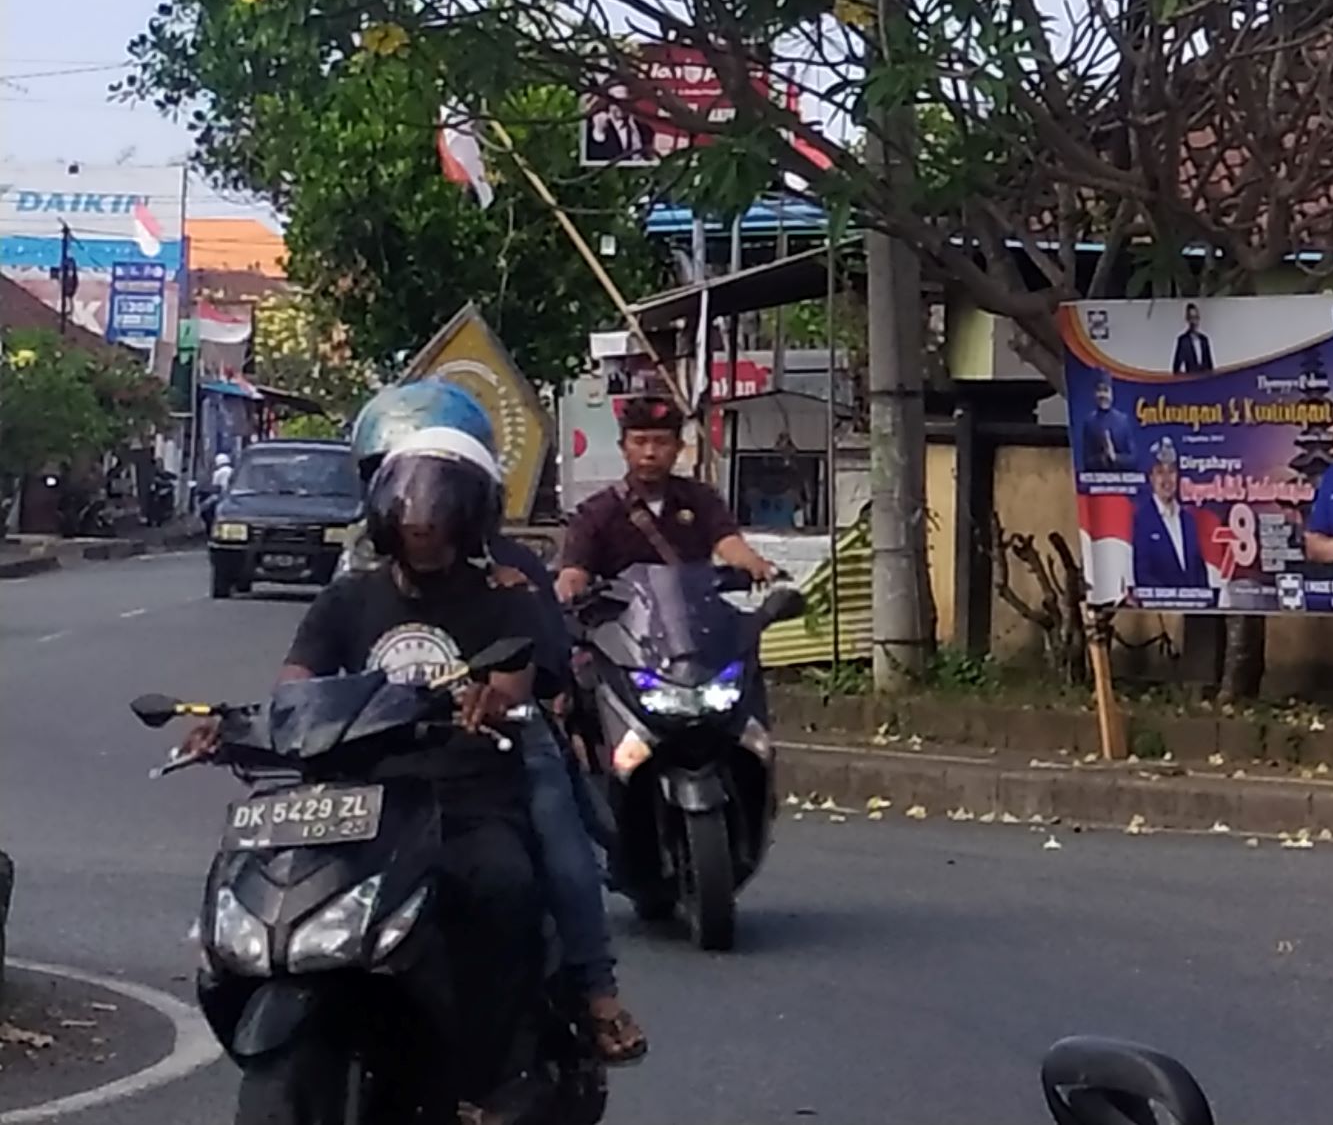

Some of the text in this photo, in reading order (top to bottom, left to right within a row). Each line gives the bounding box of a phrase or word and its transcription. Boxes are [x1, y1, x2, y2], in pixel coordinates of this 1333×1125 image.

[233, 795, 368, 828] DK 5429 ZL
